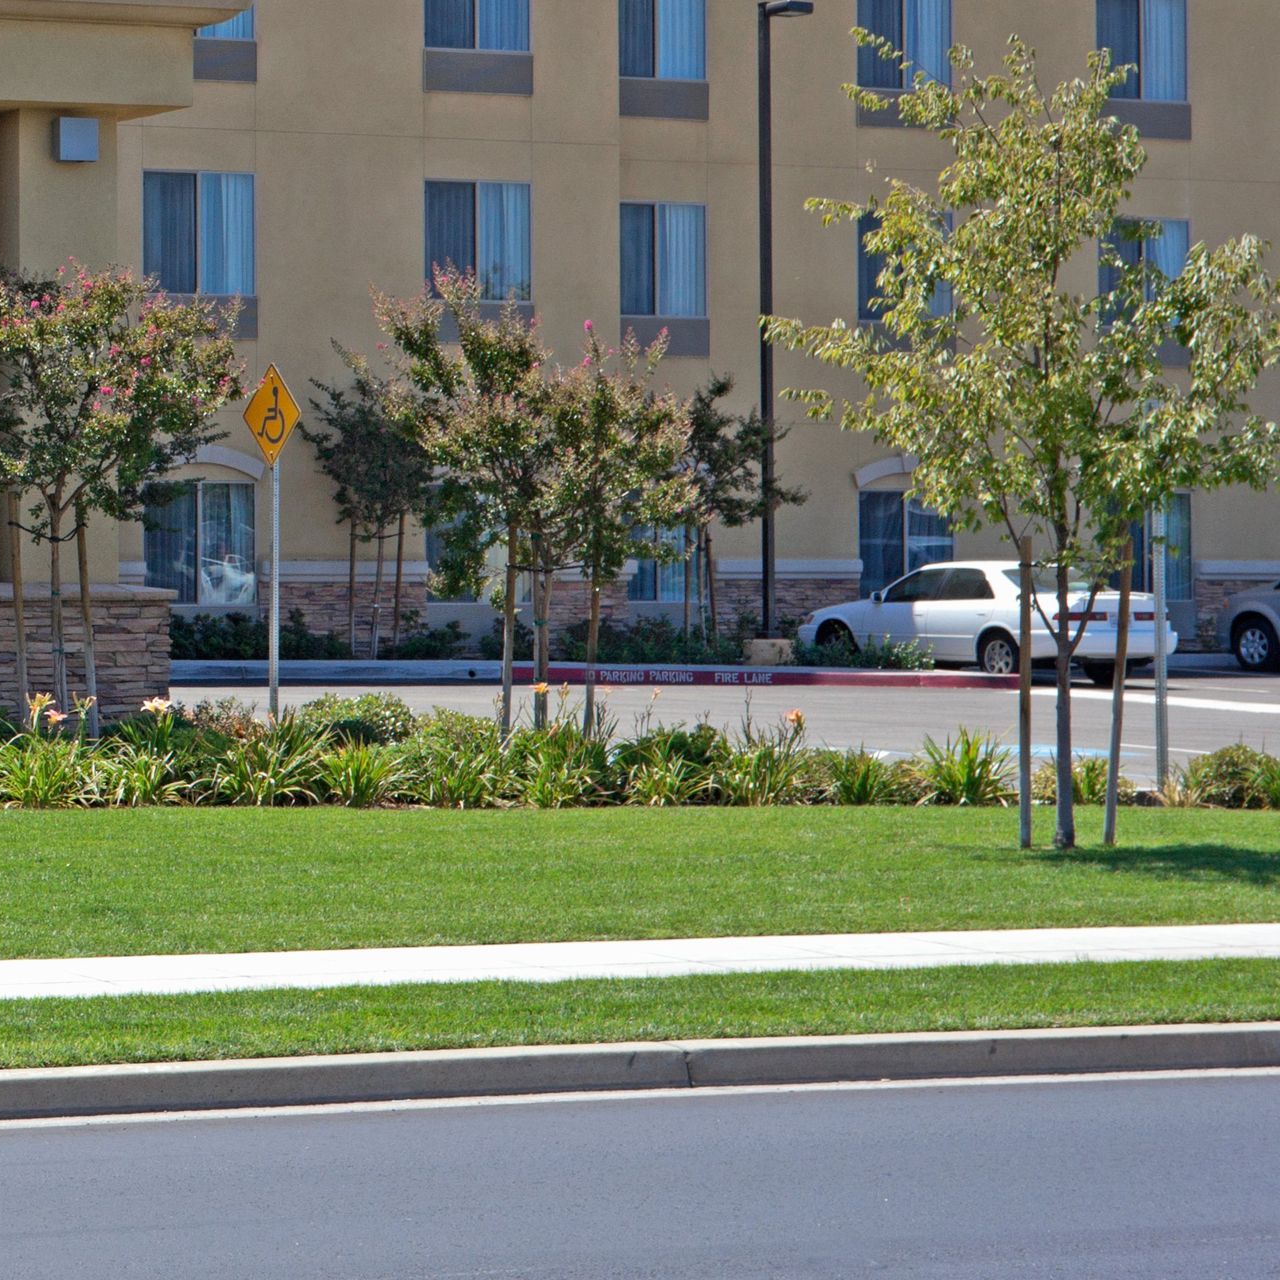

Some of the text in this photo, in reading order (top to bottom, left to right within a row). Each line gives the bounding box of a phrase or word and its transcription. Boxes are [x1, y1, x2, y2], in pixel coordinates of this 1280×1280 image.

[649, 670, 694, 683] PARKING
[714, 672, 739, 684] FIRE
[744, 673, 773, 685] LANE
